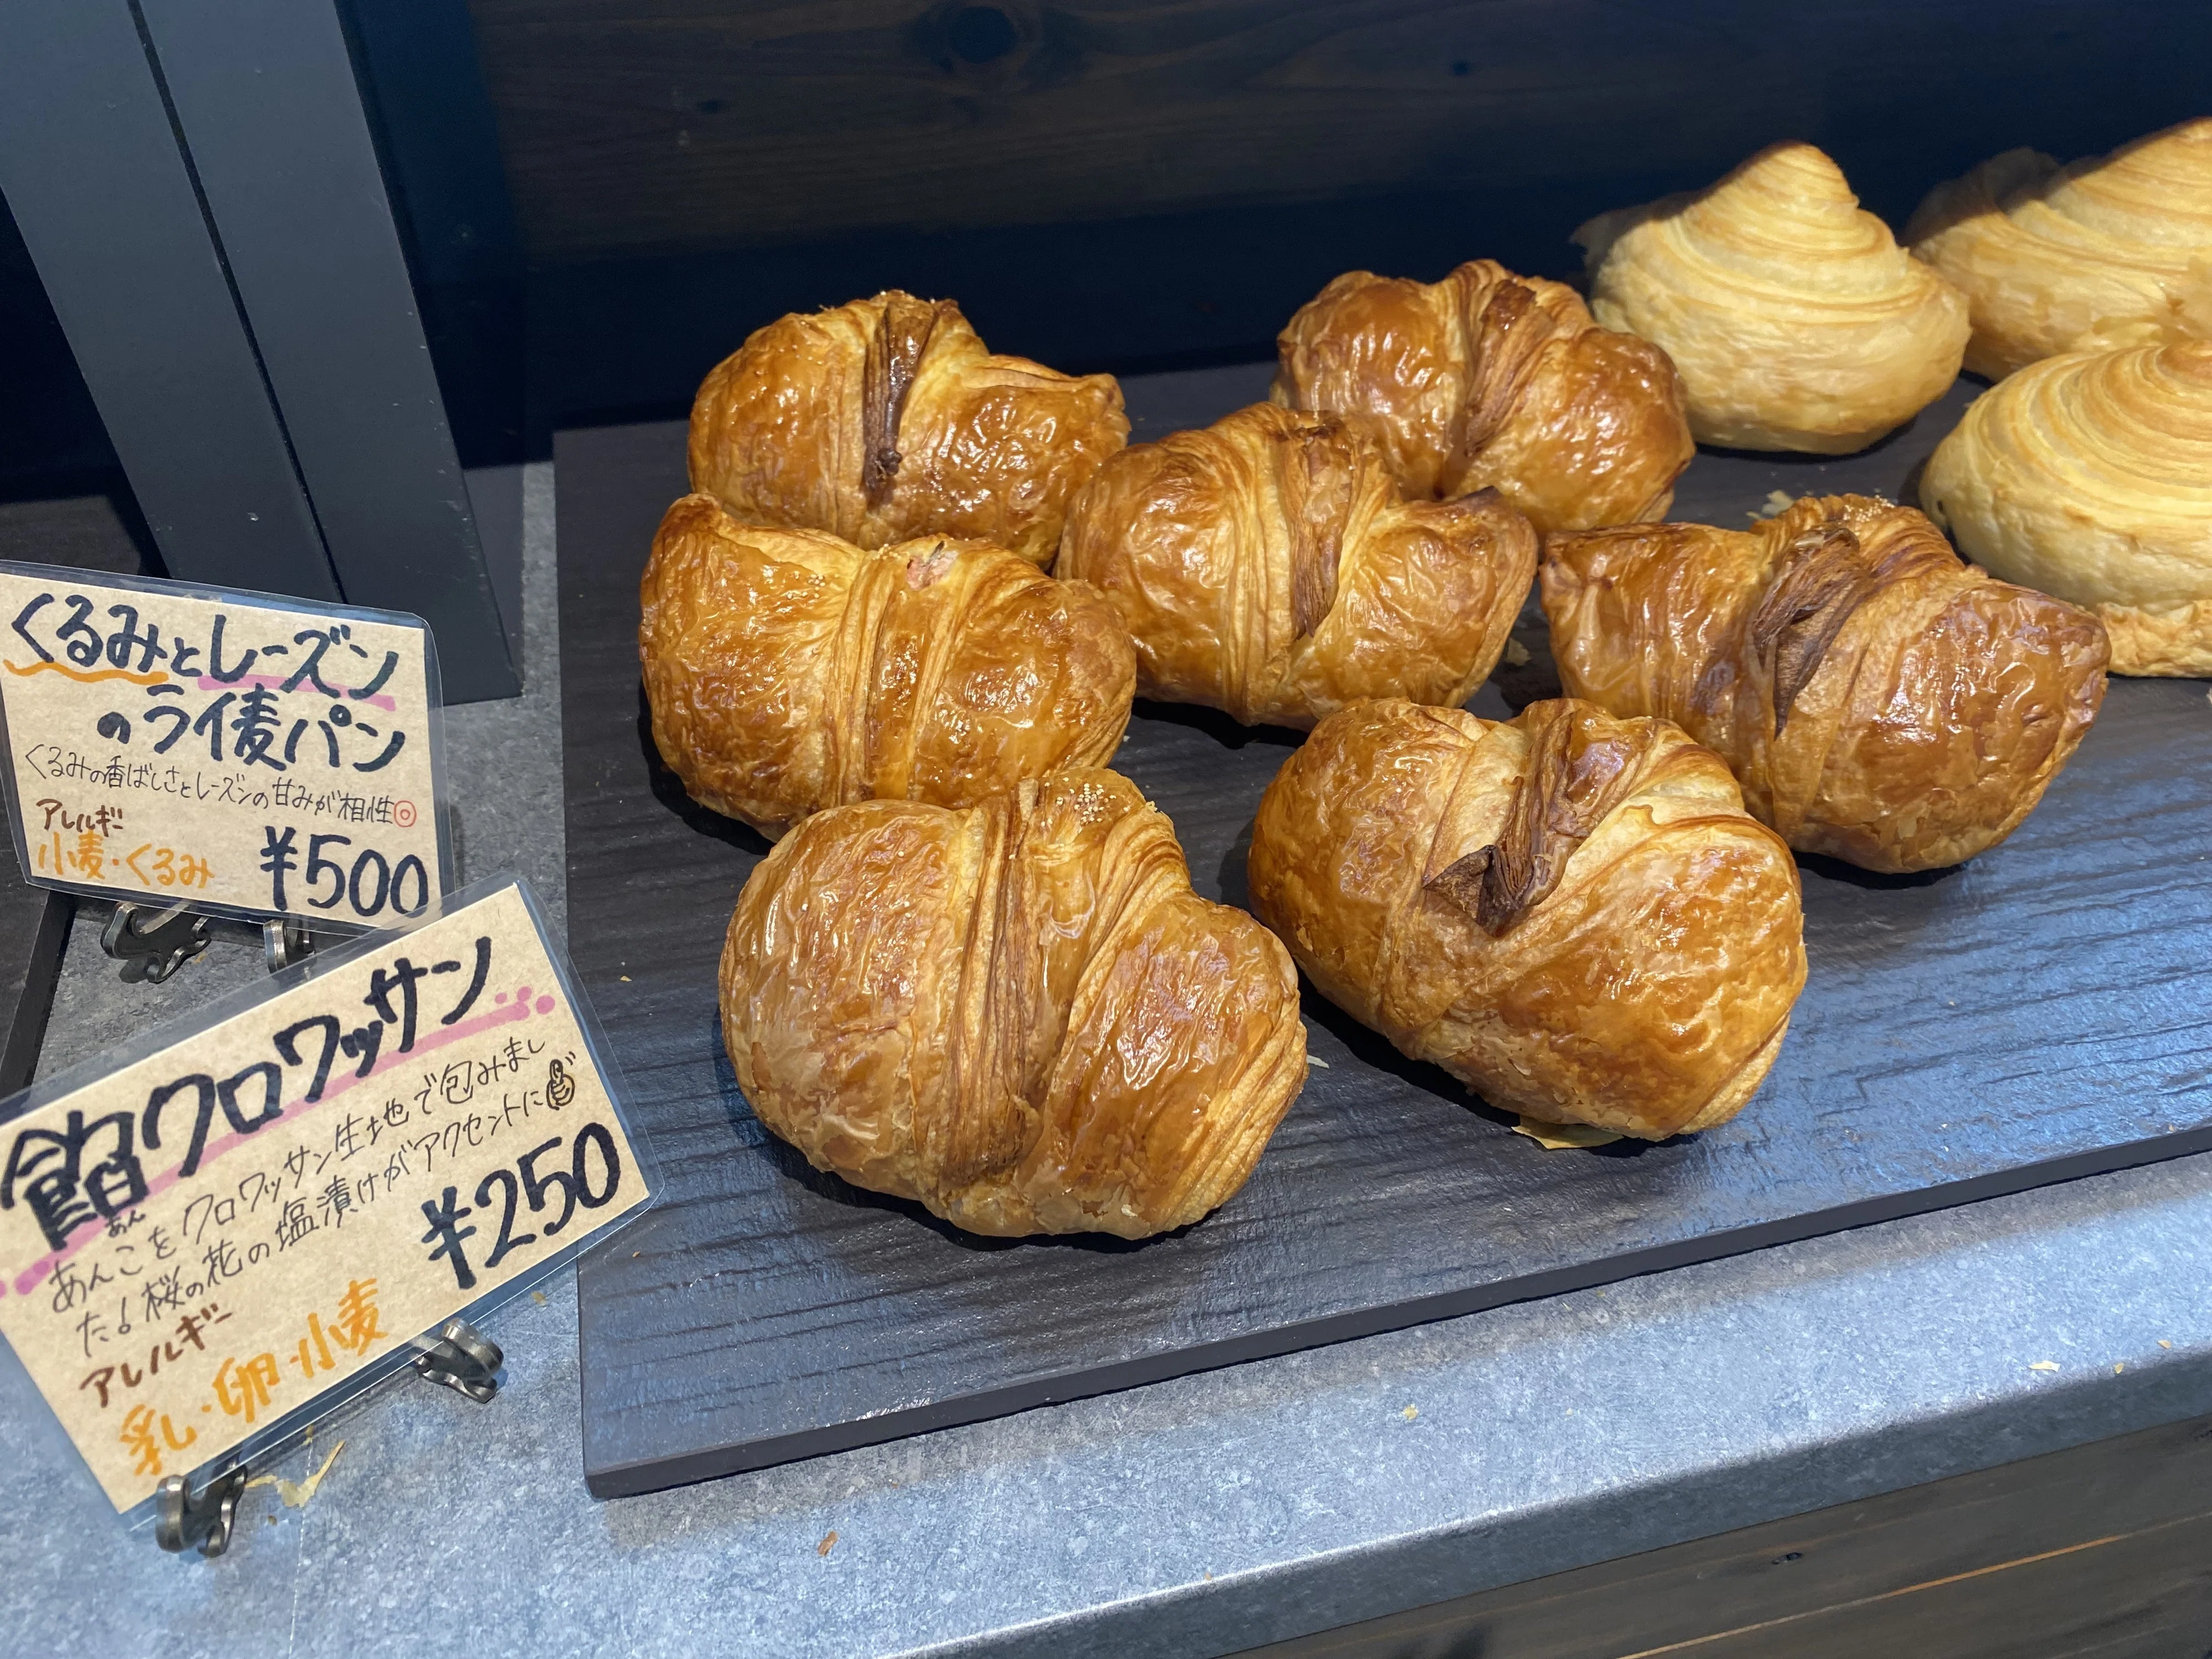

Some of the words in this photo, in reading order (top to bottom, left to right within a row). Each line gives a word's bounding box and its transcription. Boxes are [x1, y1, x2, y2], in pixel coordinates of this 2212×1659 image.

[11, 593, 400, 699] くるみとレーズン
[97, 682, 406, 771] のライ麦パン
[259, 825, 429, 919] ¥500
[0, 935, 493, 1252] 餡クロワッサン
[48, 1036, 546, 1313] あんこをクロワッサン生地で包みまし
[104, 1209, 146, 1238] あん
[420, 1121, 620, 1290] ¥250
[80, 1303, 234, 1408] アレルギー
